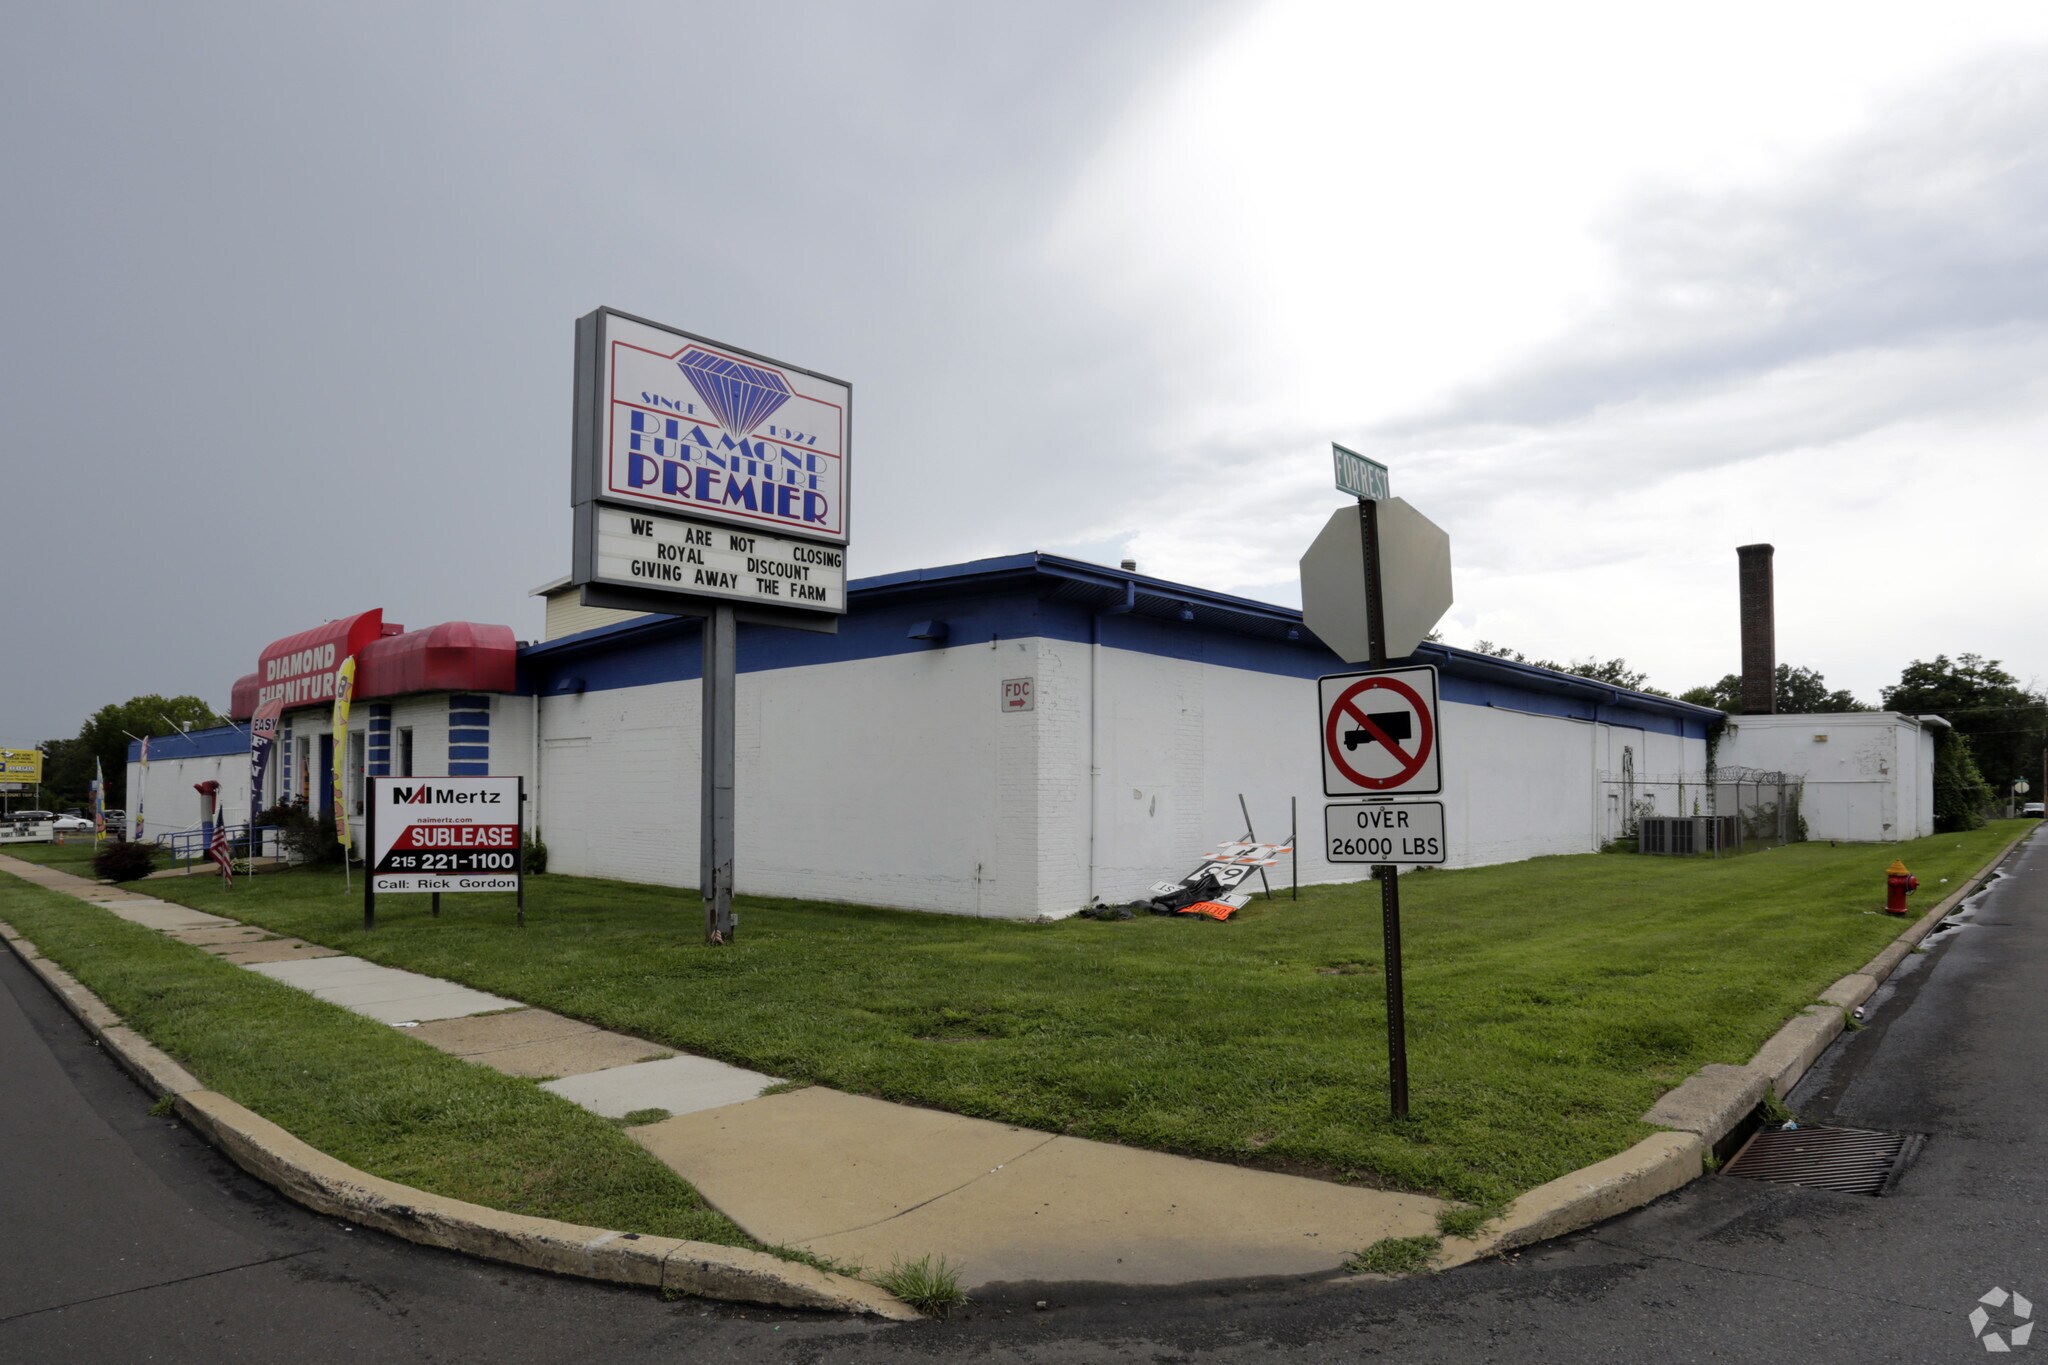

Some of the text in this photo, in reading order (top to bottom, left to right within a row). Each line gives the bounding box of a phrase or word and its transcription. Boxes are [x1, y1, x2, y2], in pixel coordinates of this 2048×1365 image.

[641, 391, 817, 446] SINCE 1927
[630, 409, 828, 475] DIAMOND
[630, 432, 825, 493] FURNITURE
[1335, 450, 1388, 500] FORREST
[627, 451, 828, 526] PREMIER
[630, 518, 842, 568] WE ARE NOT CLOSING
[657, 543, 810, 581] ROYAL DISCOUNT
[631, 560, 827, 602] GIVING AWAY THE FARM
[266, 643, 336, 682] DIAMOND
[1005, 682, 1030, 697] FDC
[254, 718, 278, 731] EASY
[393, 783, 501, 805] NAI Mertz
[417, 816, 473, 824] naimertz.com
[1357, 811, 1409, 829] OVER
[411, 827, 513, 847] SUBLEASE
[1332, 837, 1439, 855] 26000 LBS
[391, 853, 514, 870] 215 221-1100
[377, 879, 516, 889] Call: Rick Gordon
